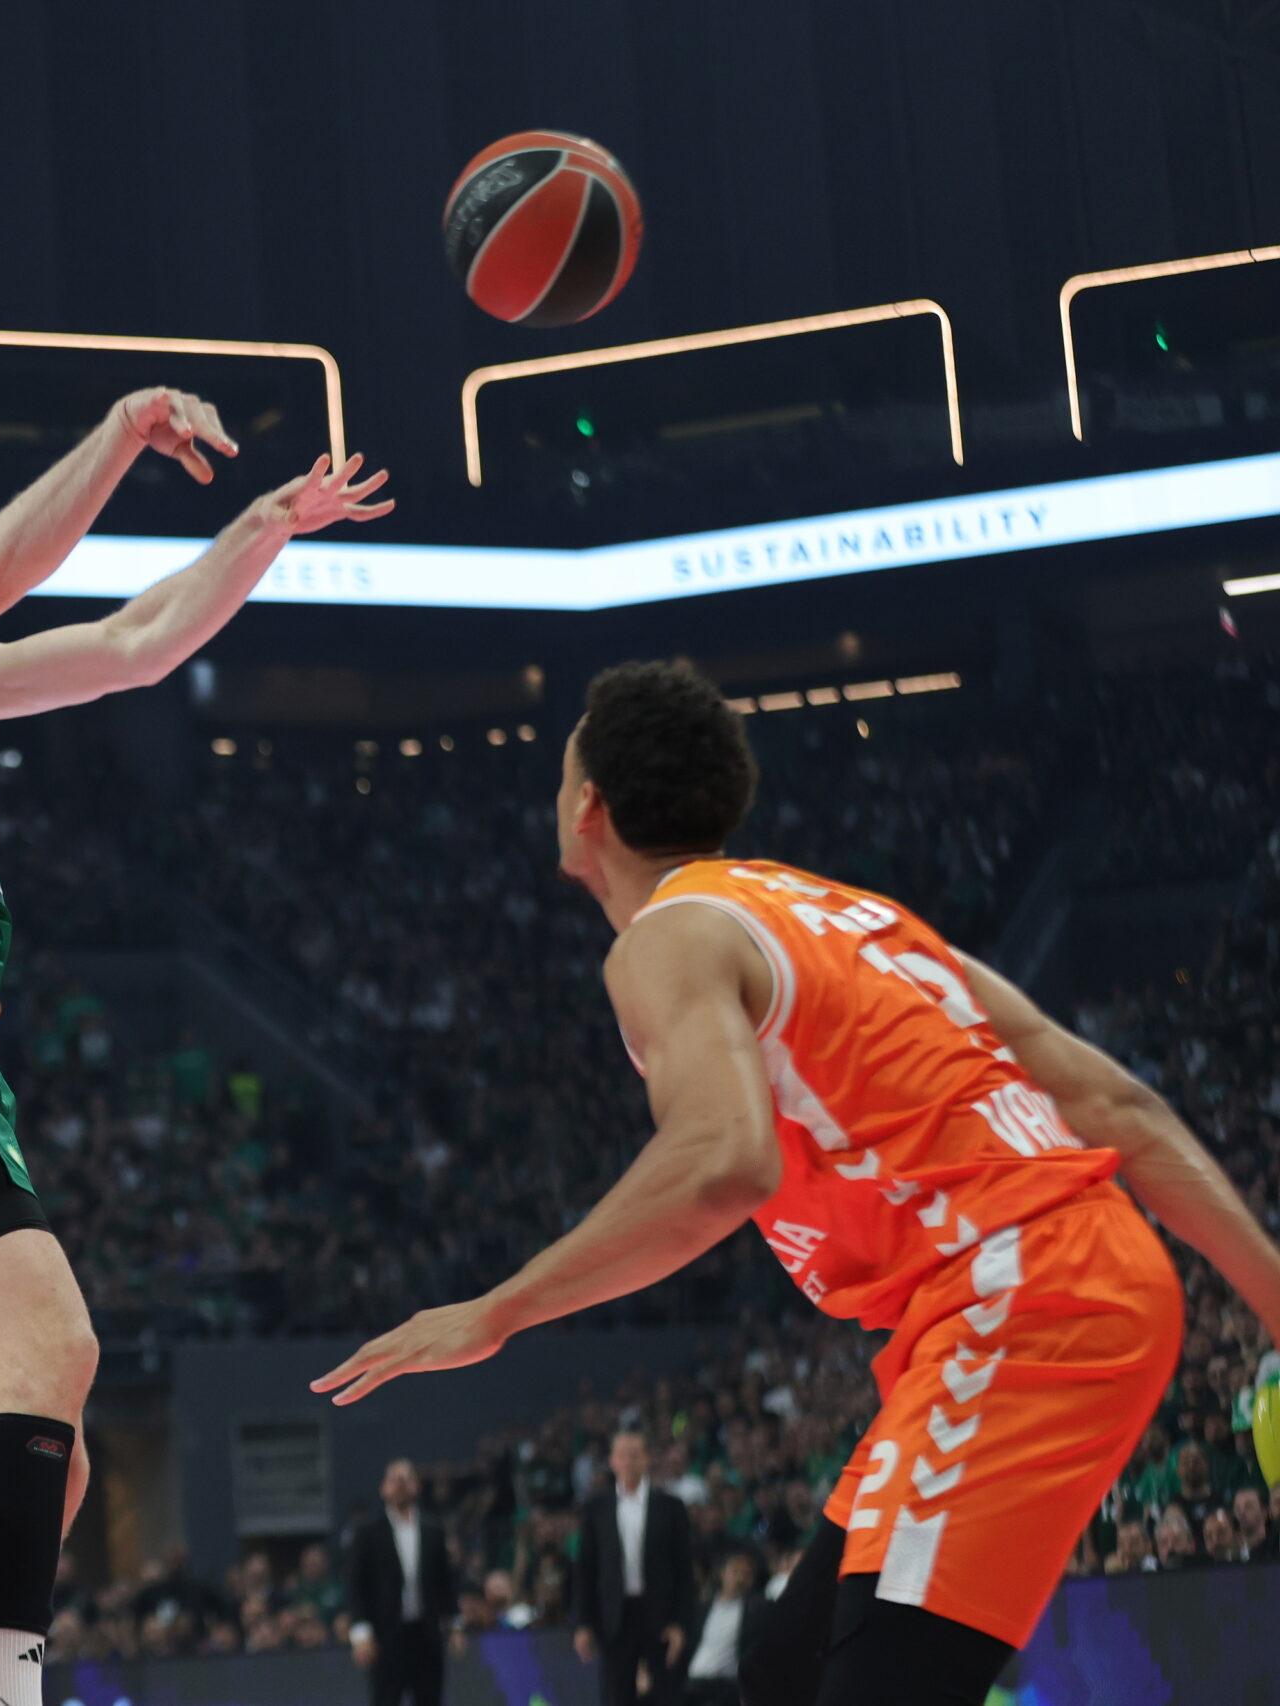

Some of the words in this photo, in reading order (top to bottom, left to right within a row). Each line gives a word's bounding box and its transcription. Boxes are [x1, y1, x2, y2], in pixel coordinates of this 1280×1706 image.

[268, 560, 375, 593] EETS
[672, 504, 1049, 584] SUSTAINABILITY
[847, 1440, 898, 1531] 2
